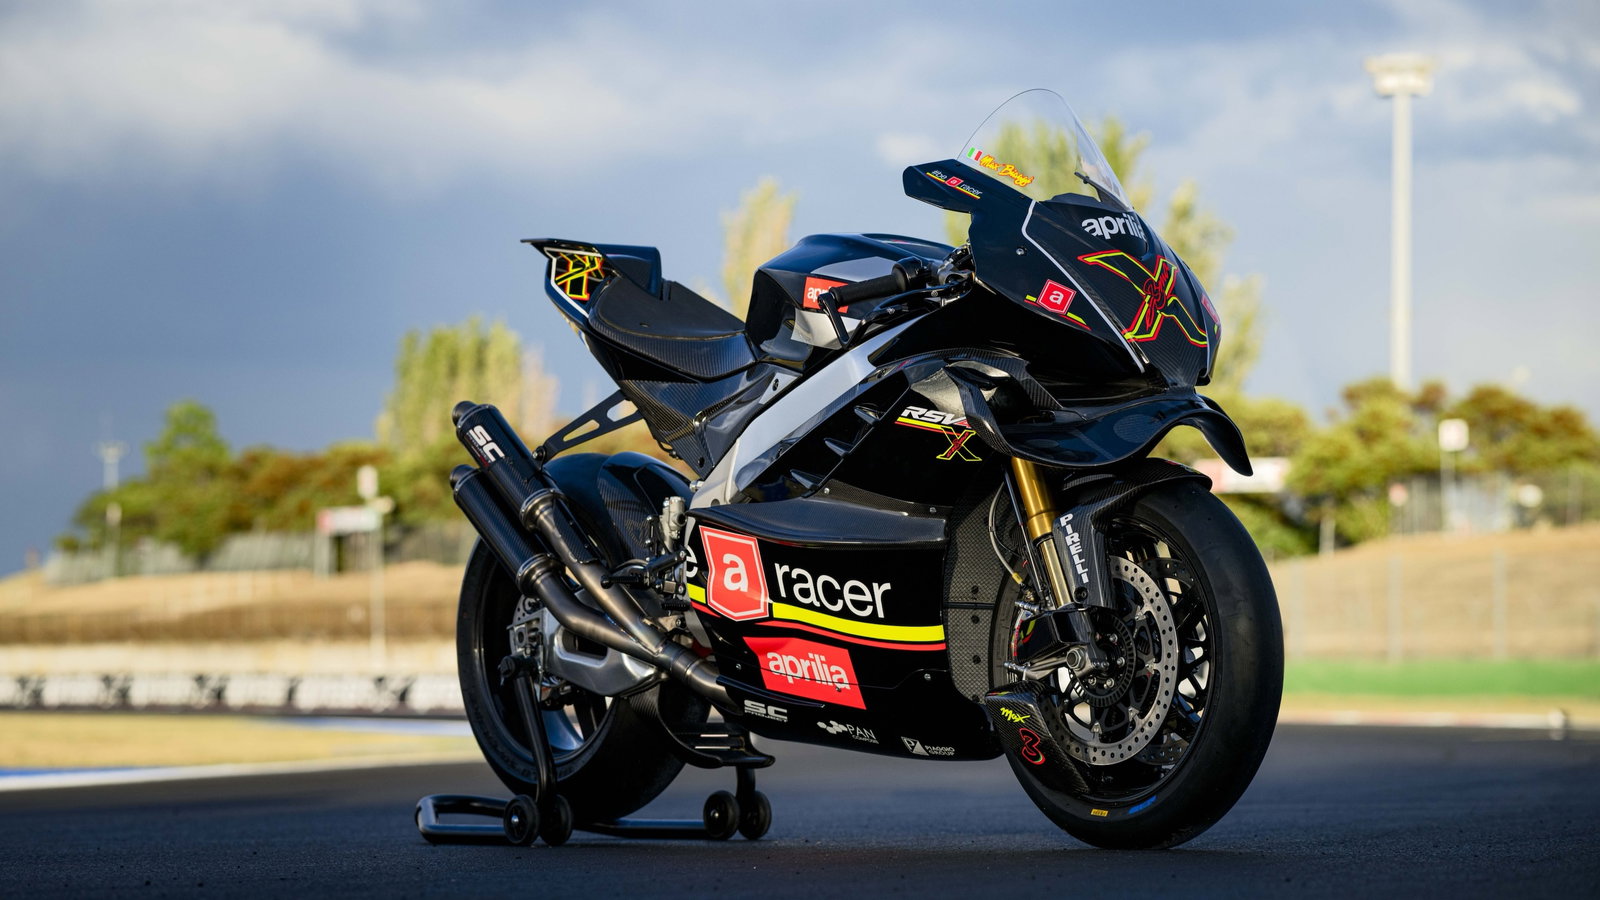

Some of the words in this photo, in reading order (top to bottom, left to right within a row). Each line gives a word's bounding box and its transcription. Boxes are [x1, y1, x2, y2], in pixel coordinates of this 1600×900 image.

[960, 183, 983, 196] racer
[1049, 290, 1065, 305] a
[468, 425, 505, 463] SC
[1060, 513, 1089, 584] PIRELLI
[722, 553, 749, 592] a
[774, 562, 892, 619] racer
[766, 651, 851, 690] aprilia
[744, 699, 788, 720] SC
[846, 723, 877, 740] PAN
